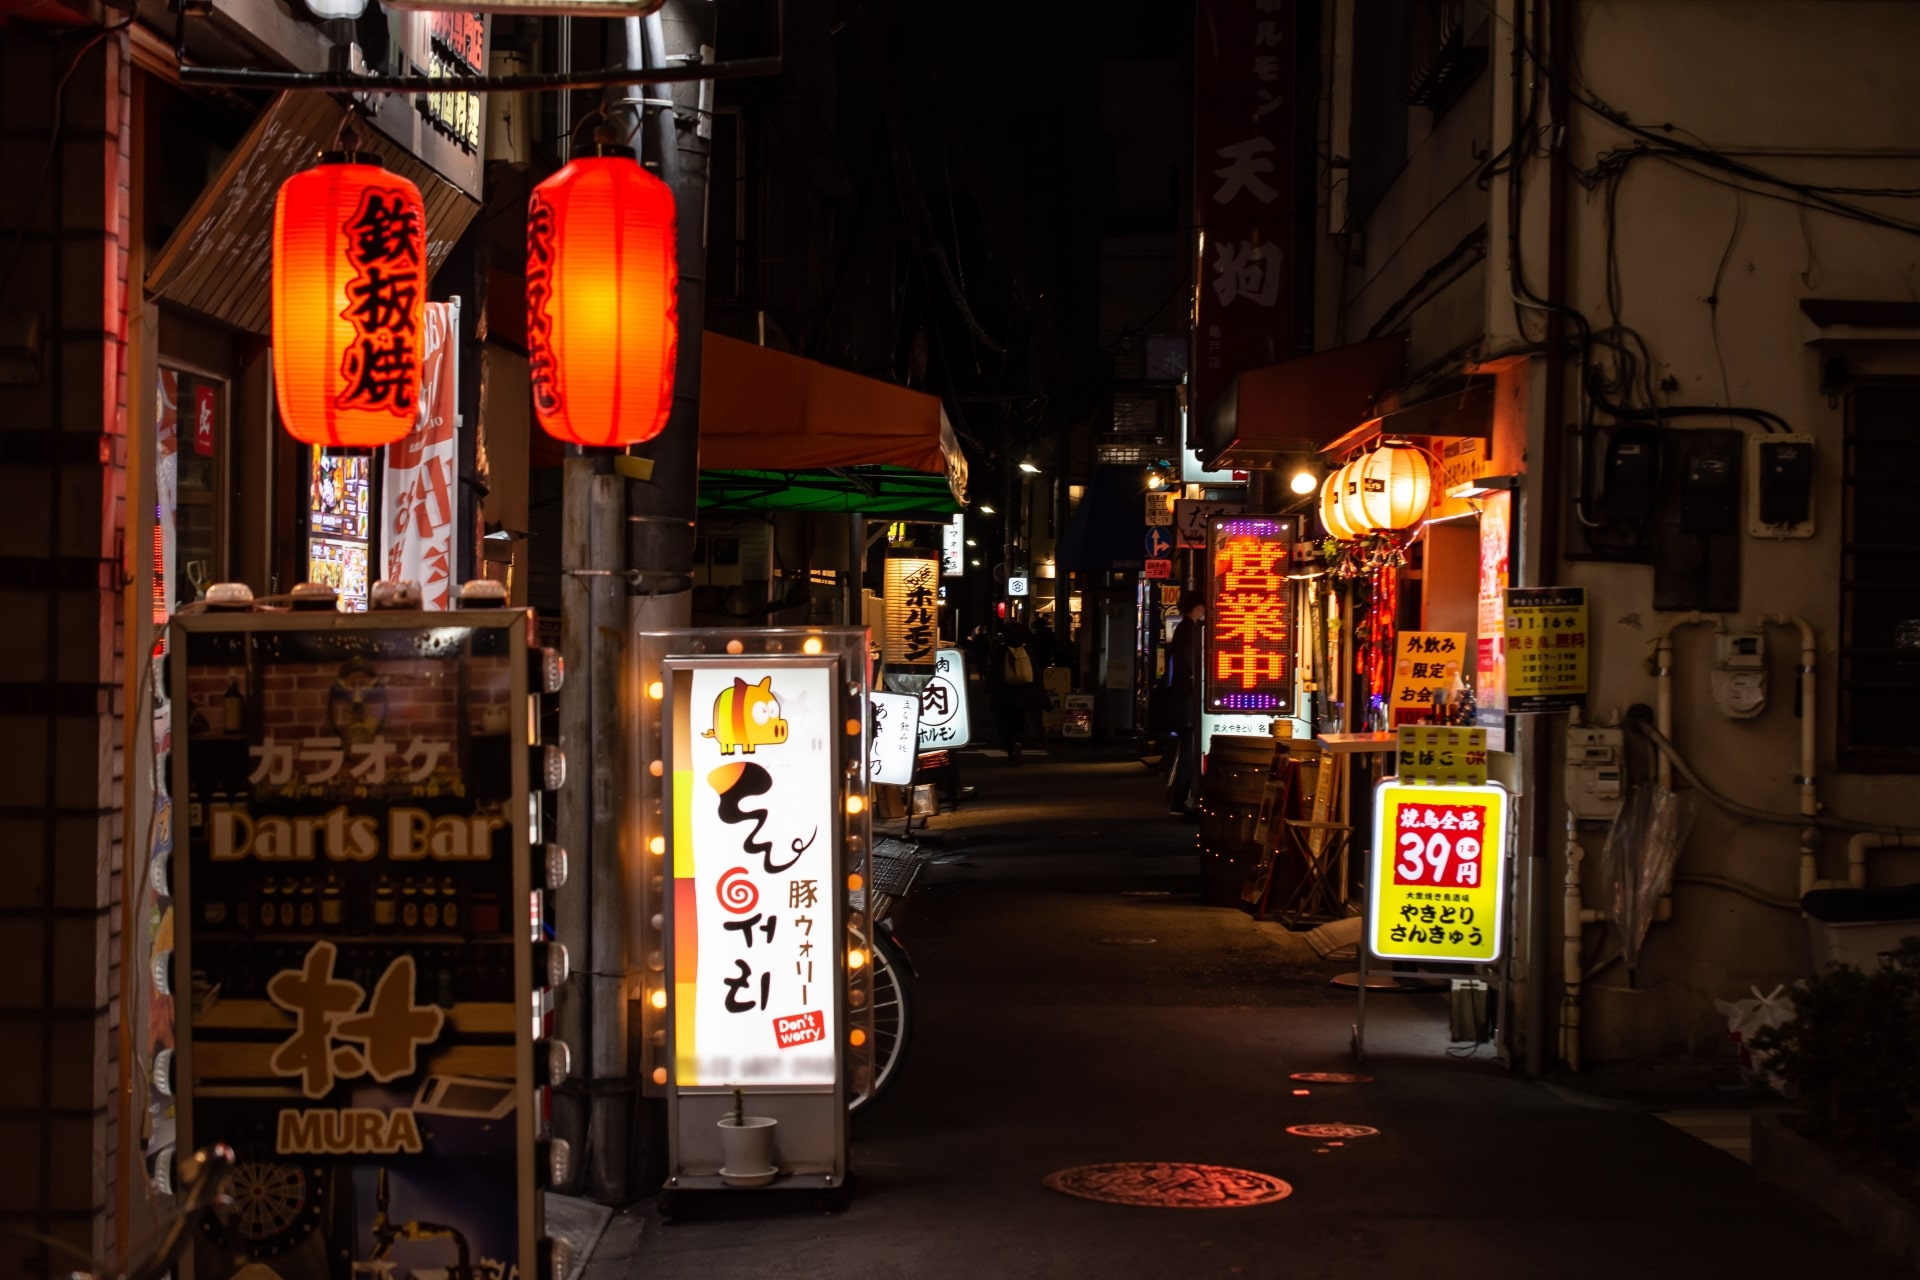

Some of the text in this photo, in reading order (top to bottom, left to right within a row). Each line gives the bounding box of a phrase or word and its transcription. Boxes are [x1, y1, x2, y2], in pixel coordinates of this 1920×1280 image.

[1212, 135, 1284, 308] 天狗
[903, 586, 933, 662] ホルモン
[1215, 541, 1287, 689] 営業中
[1407, 636, 1456, 653] 外飲み
[1412, 662, 1446, 678] 限定
[918, 683, 949, 717] 肉
[1400, 686, 1432, 703] お会
[918, 727, 957, 743] ホルモン
[247, 735, 450, 785] カラオケ
[1399, 750, 1487, 766] たばこ OK
[1400, 808, 1480, 831] 焼鳥全品
[210, 805, 504, 861] Darts Bar
[1397, 832, 1478, 885] 39 円
[1400, 904, 1474, 925] やきとり
[789, 879, 818, 1006] 豚ウォリー
[1390, 923, 1483, 946] さんきゅう
[778, 1013, 816, 1033] Don't
[780, 1027, 821, 1044] worry
[276, 1108, 424, 1155] MURA
